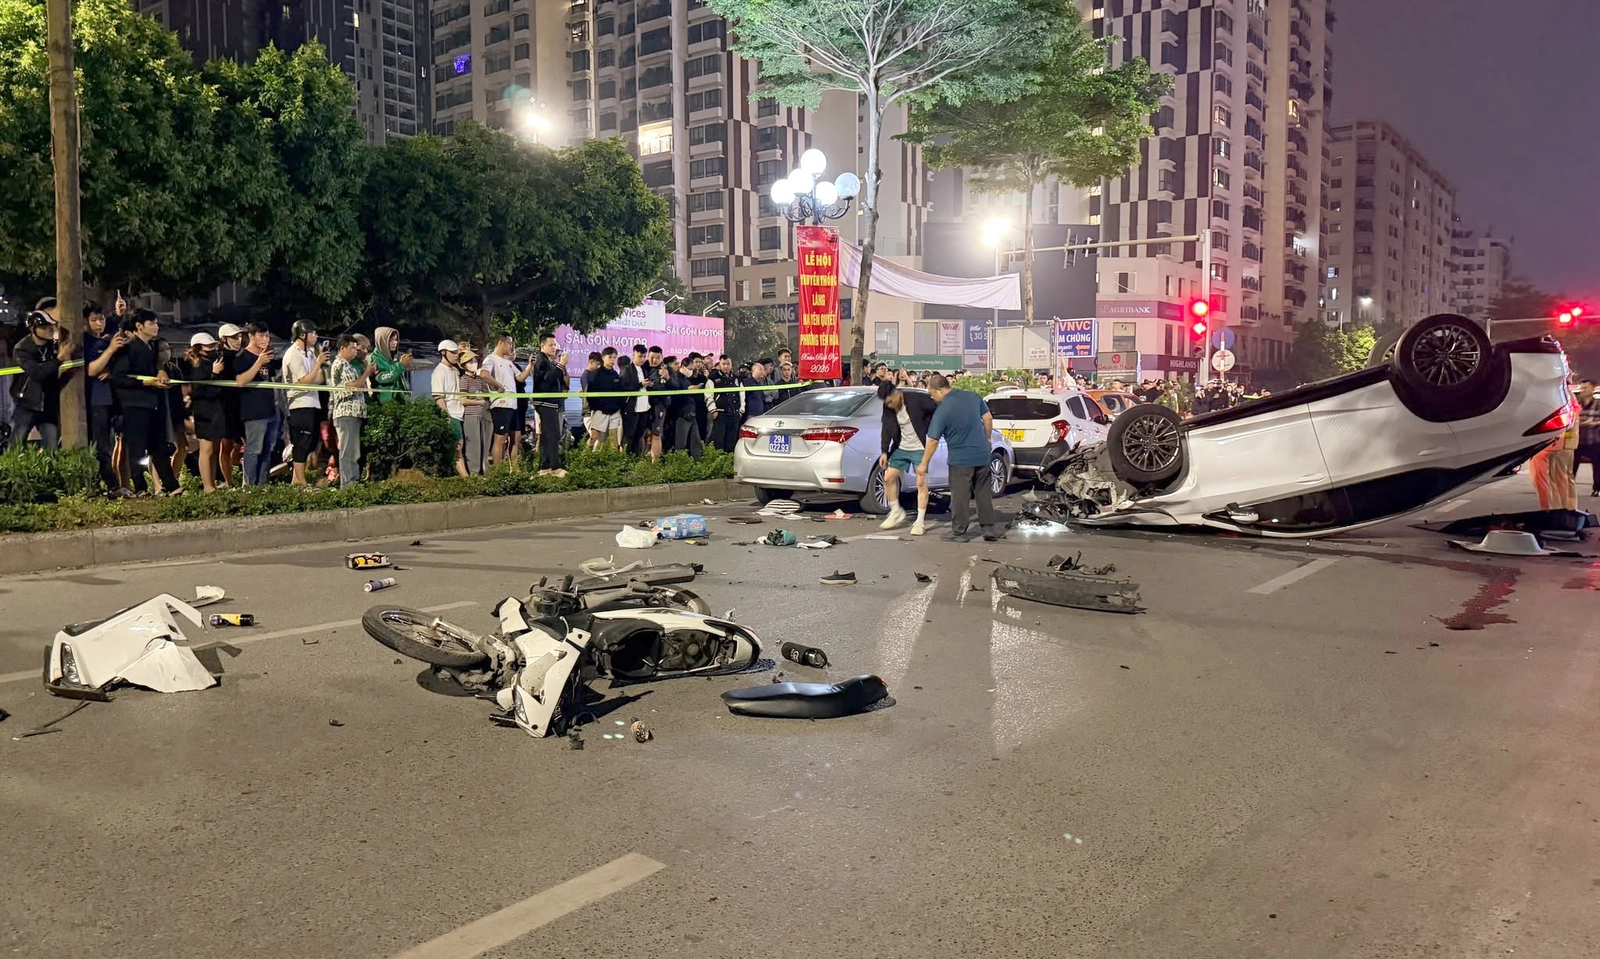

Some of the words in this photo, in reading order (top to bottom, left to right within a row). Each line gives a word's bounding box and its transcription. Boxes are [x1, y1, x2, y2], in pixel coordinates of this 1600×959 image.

[816, 252, 832, 268] HỘI
[624, 309, 646, 318] vices
[1060, 320, 1090, 332] VNVC
[698, 329, 722, 338] MOTOR
[1066, 332, 1091, 342] CHỦNG
[612, 335, 648, 348] MOTOR
[810, 364, 830, 373] 2026
[774, 434, 785, 443] 29A
